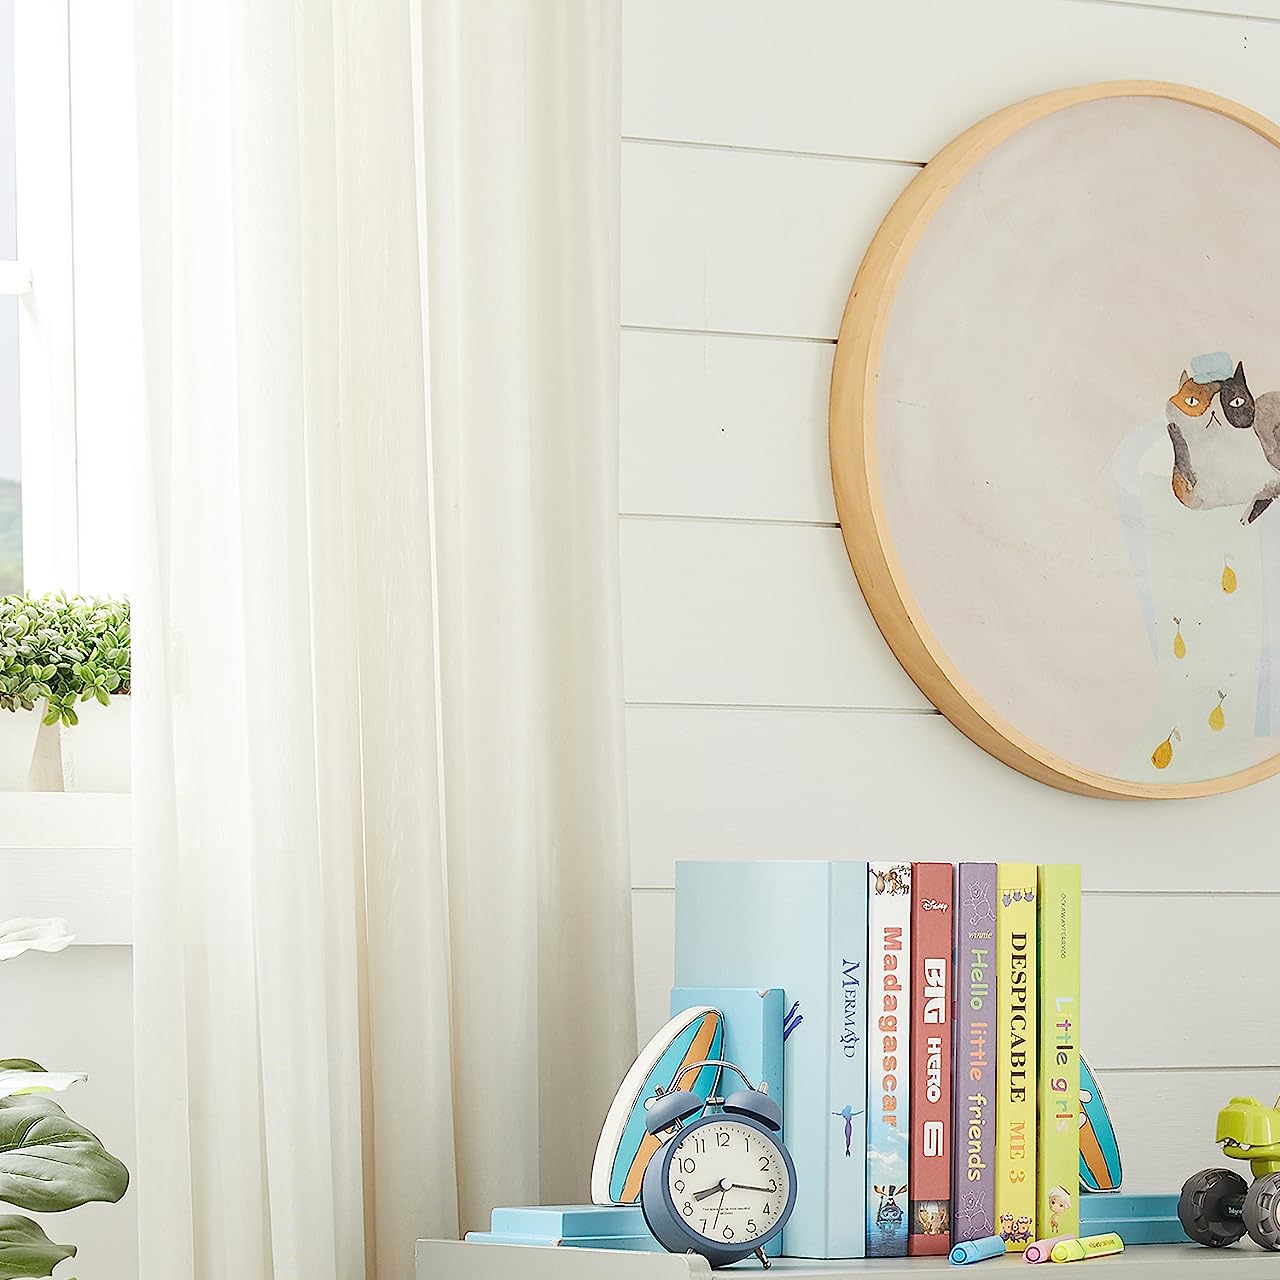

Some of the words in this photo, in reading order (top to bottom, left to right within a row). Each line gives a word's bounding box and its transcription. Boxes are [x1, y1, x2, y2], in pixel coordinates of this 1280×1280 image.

[969, 948, 989, 1011] Hello
[923, 957, 947, 1025] BIG
[1010, 931, 1027, 1103] DESPICABLE
[878, 926, 903, 1128] Madagascar
[969, 1022, 989, 1081] little
[926, 1037, 942, 1104] HERO
[715, 1132, 730, 1147] 12
[744, 1137, 749, 1152] 1
[967, 1092, 988, 1182] friends
[1009, 1120, 1026, 1160] ME
[695, 1138, 705, 1153] 11
[678, 1157, 696, 1173] 10
[758, 1156, 770, 1172] 2
[1009, 1168, 1026, 1184] 3
[674, 1180, 685, 1194] 9
[682, 1201, 693, 1217] 8
[762, 1202, 771, 1215] 4
[699, 1219, 707, 1233] 7
[722, 1225, 734, 1239] 6
[745, 1219, 757, 1233] 5
